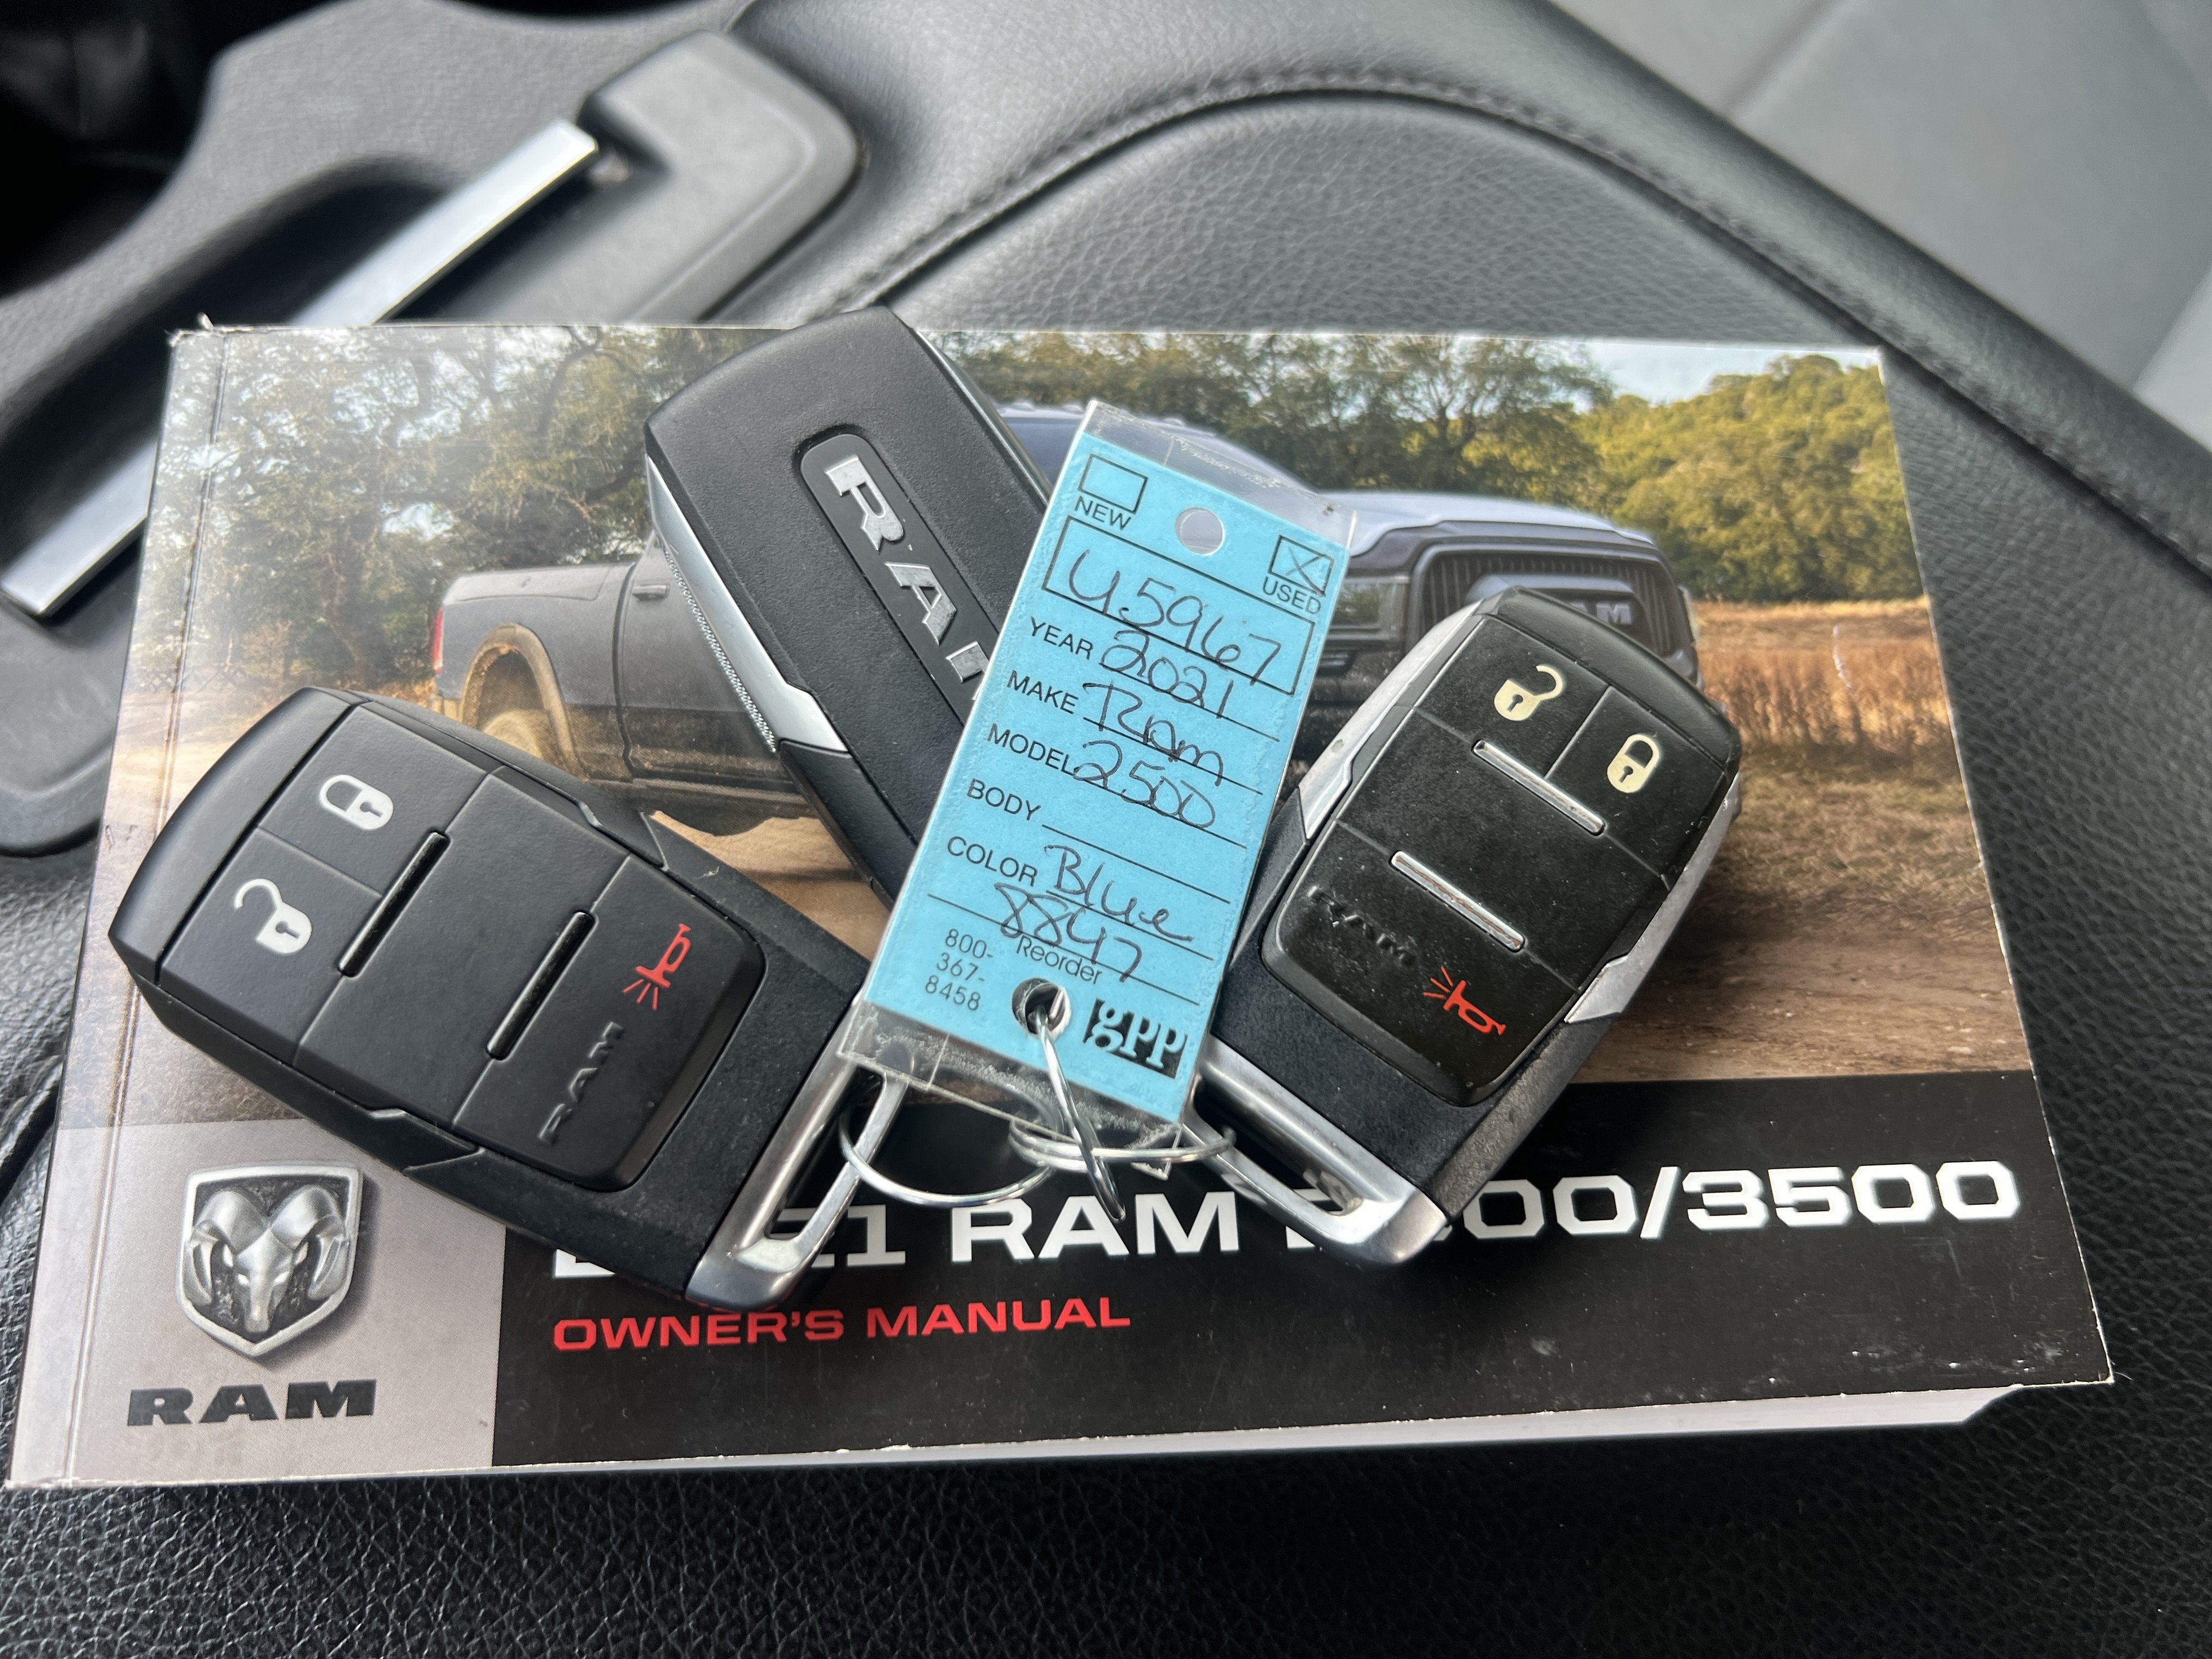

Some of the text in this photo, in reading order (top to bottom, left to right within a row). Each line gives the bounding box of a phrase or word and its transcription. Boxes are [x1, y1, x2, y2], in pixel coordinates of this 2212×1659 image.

[1074, 495, 1132, 531] NEW
[1262, 577, 1322, 616] USED
[1030, 616, 1094, 659] YEAR
[1006, 669, 1079, 714] MAKE
[1098, 629, 1234, 719] 2021
[987, 723, 1074, 776] MODEL
[1082, 680, 1224, 786] Ram
[966, 778, 1041, 822] BODY
[1073, 740, 1216, 829] 2500
[947, 836, 1039, 887] COLOR
[1044, 844, 1193, 943] Blue
[1016, 935, 1103, 985] Reorder
[924, 975, 983, 1012] 8458
[950, 1191, 1240, 1264] RAM
[1286, 1160, 2020, 1249] 00/3500
[553, 1296, 1131, 1352] OWNER'S MANUAL
[127, 1379, 377, 1427] RAM
